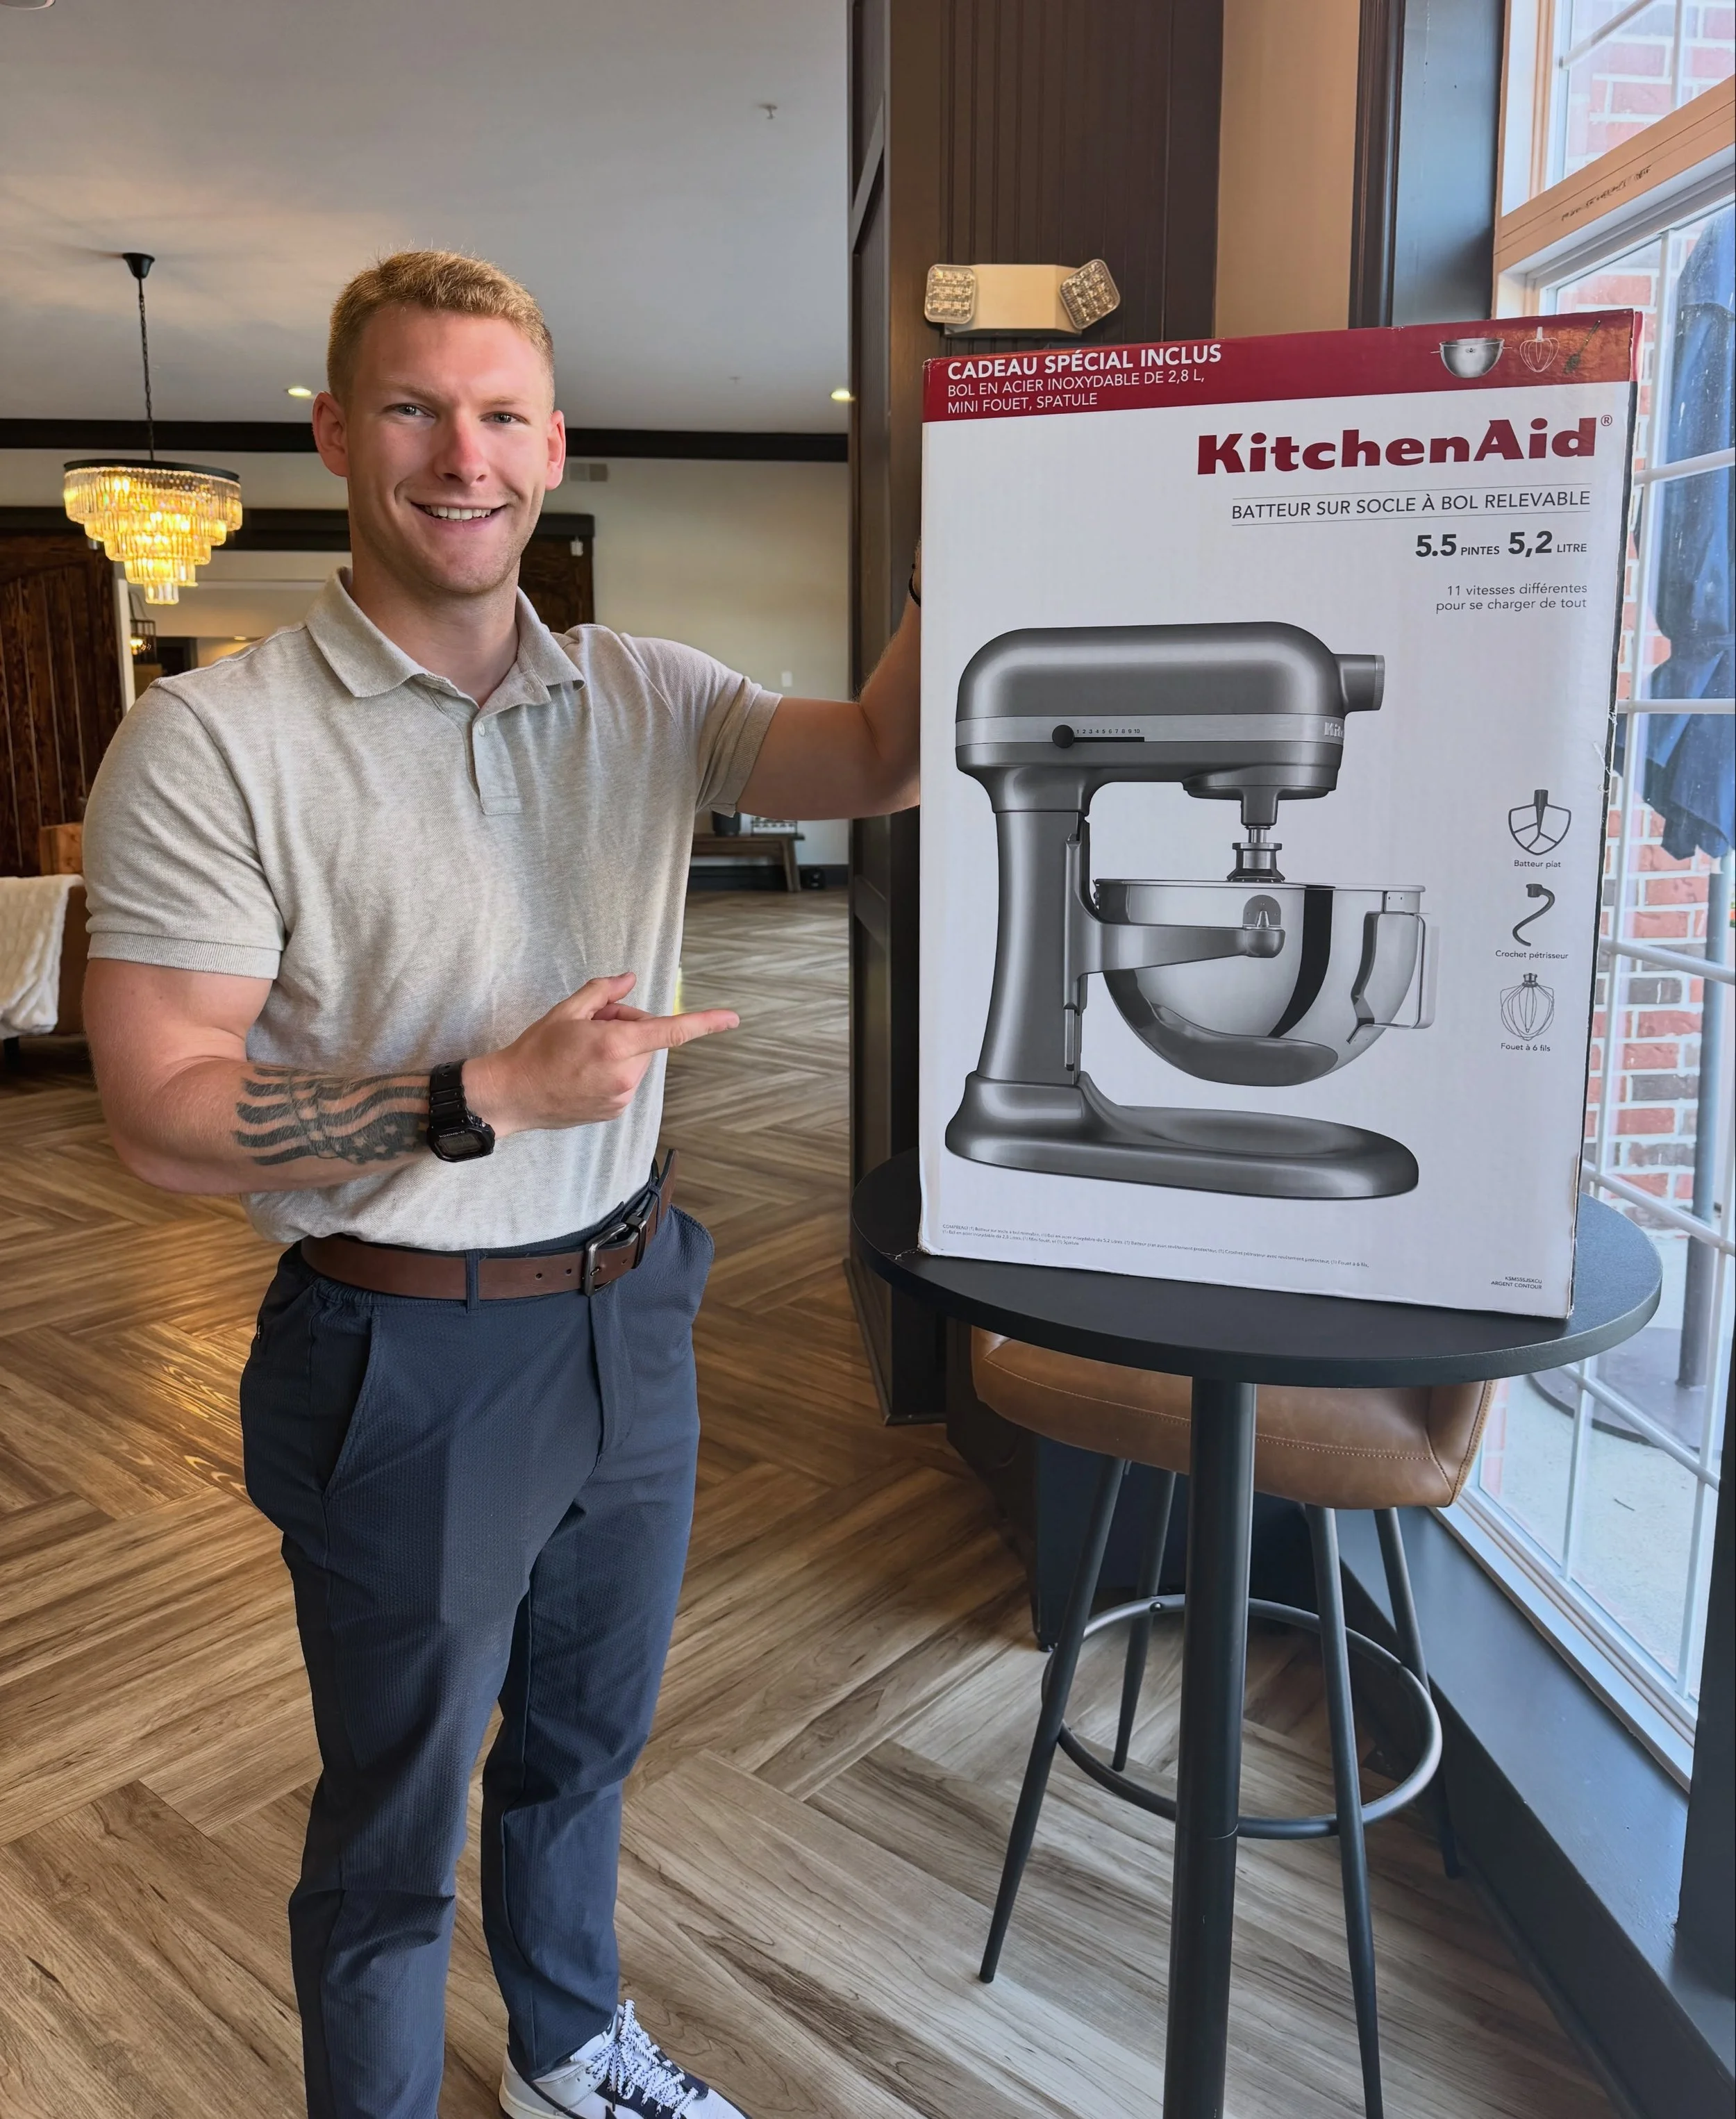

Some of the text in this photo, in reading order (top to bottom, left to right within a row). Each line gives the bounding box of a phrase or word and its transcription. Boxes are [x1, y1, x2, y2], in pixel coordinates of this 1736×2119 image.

[948, 344, 1221, 380] CADEAU SPÉCIAL INCLUS
[948, 369, 1205, 397] BOL EN ACIER INOXYDABLE DE 2,8 L,
[948, 392, 1098, 414] MINI FOUET, SPATULE
[1232, 490, 1590, 520] BATTEUR SUR SOCLE À BOL RELEVABLE
[1415, 531, 1587, 558] 5.5 PINTES 5,2 LITRE
[1447, 582, 1587, 596] 11 vitesses différentes
[1436, 597, 1586, 615] pour se charger de tout
[1545, 861, 1561, 869] plat
[1495, 949, 1569, 961] Crochet pétrisseur
[1501, 1042, 1524, 1051] Fouet
